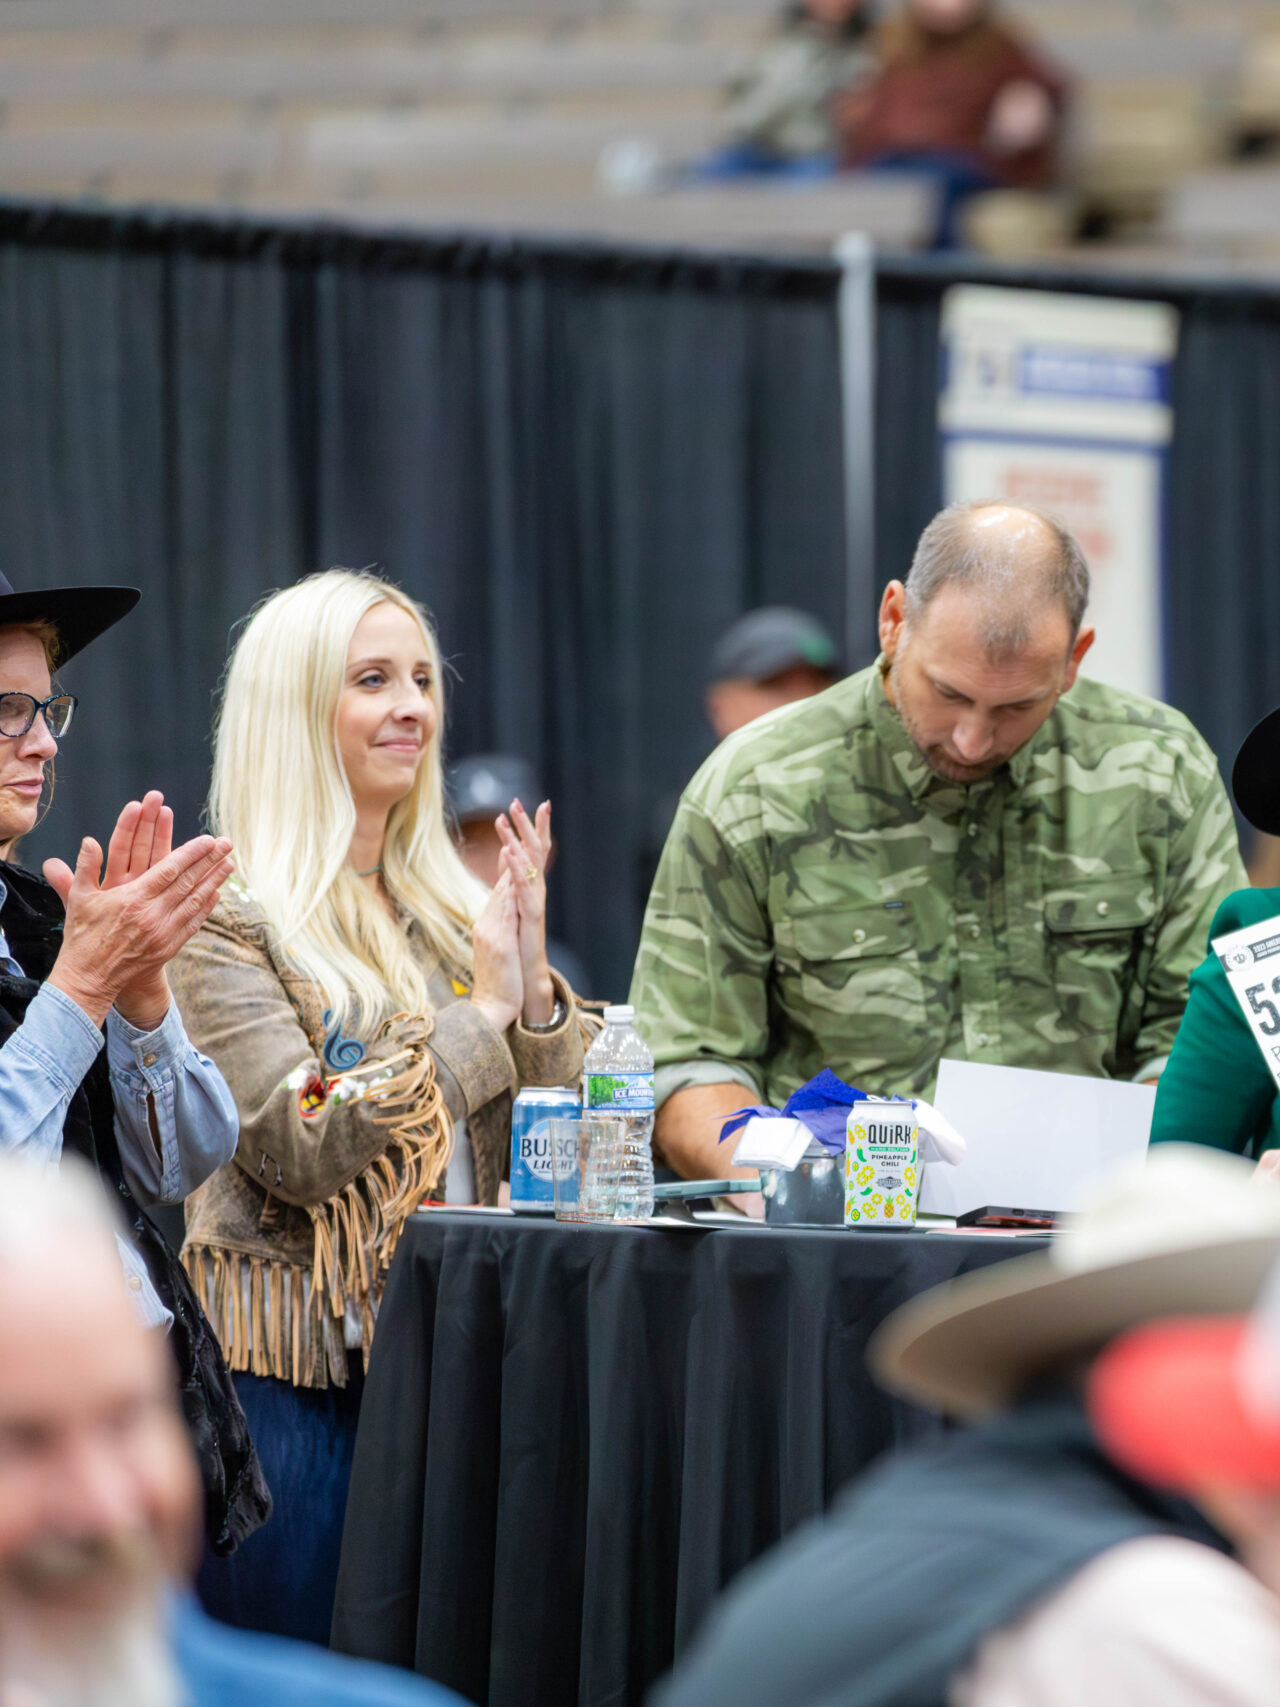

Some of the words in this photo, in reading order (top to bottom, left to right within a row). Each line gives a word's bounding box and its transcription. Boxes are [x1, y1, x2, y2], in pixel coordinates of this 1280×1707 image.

[1253, 942, 1266, 953] 2023
[615, 1089, 627, 1099] ICE
[533, 1160, 573, 1170] LIGHT
